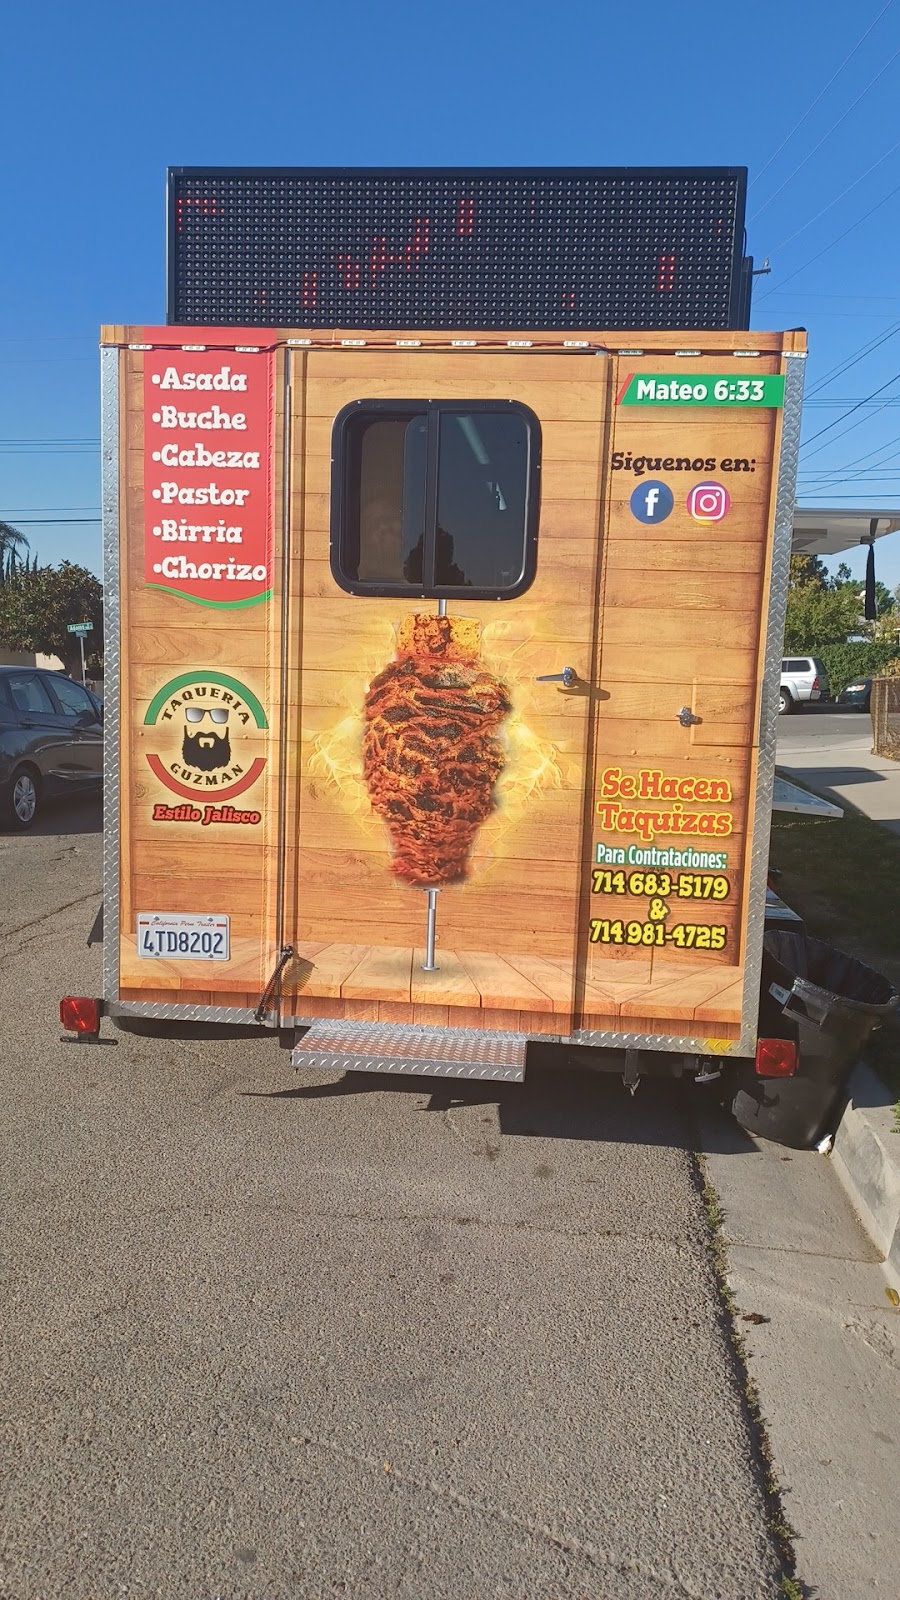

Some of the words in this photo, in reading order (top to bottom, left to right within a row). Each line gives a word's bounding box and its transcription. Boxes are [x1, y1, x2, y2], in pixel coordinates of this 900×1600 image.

[637, 380, 707, 400] Mateo
[713, 380, 765, 401] 6:33
[720, 458, 756, 473] en:
[161, 687, 250, 725] TAQUERIA
[170, 763, 244, 786] GUZMAN
[602, 768, 635, 798] Se
[638, 770, 731, 802] Hacen
[153, 804, 200, 820] Estilo
[202, 806, 261, 825] Jalisco
[597, 802, 732, 841] Taquizas
[597, 843, 625, 864] Para
[628, 846, 727, 869] Contrataciones:
[593, 870, 625, 893] 714
[629, 872, 729, 899] 683-5179
[650, 898, 669, 920] &
[143, 930, 223, 954] 4TD8202
[591, 920, 623, 943] 714
[627, 922, 726, 949] 981-4725
